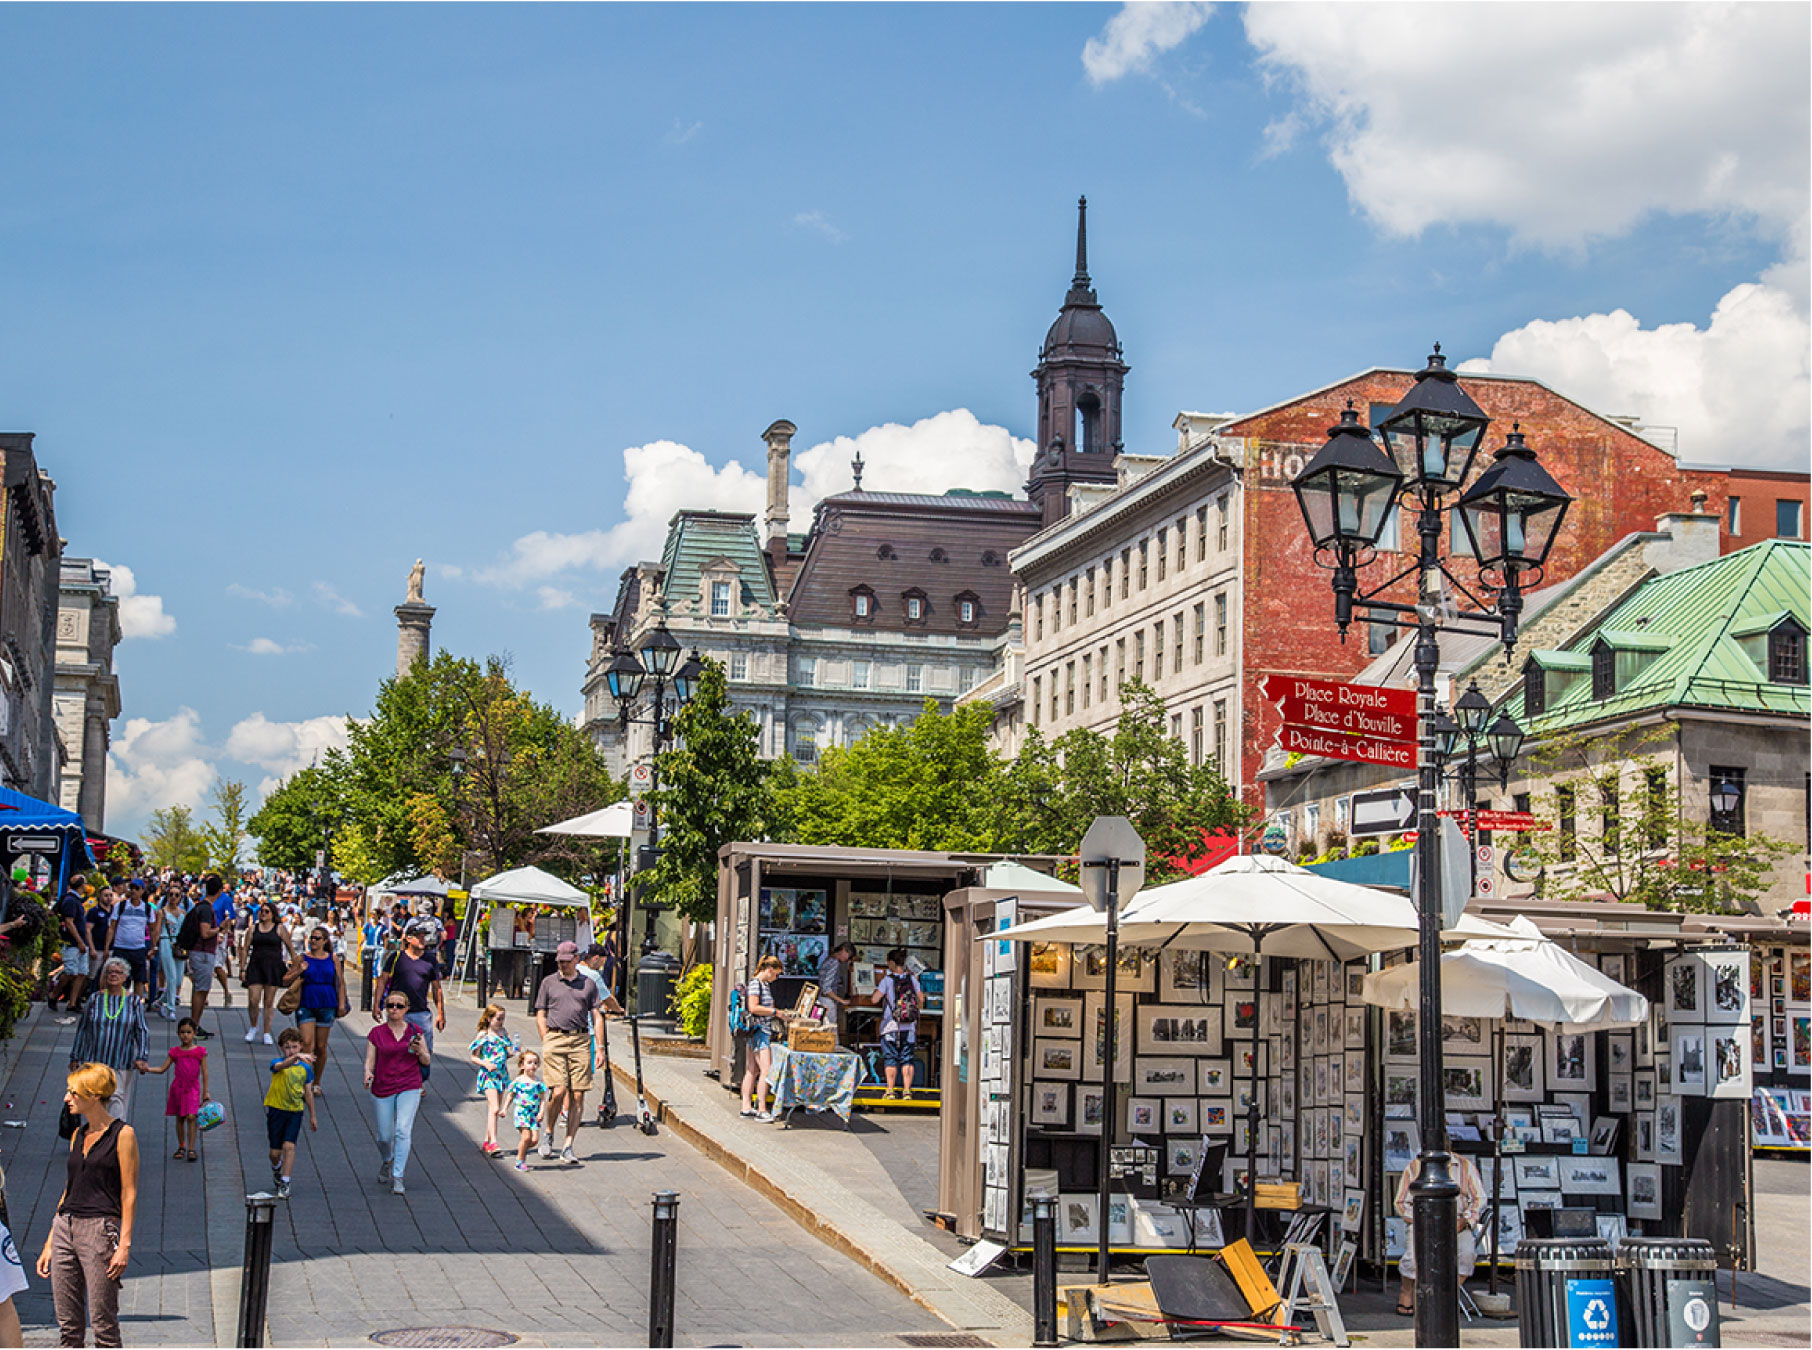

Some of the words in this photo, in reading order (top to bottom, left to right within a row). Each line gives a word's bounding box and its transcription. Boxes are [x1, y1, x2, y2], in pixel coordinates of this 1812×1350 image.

[1294, 681, 1334, 702] Place
[1338, 686, 1388, 709] Royale
[1304, 703, 1340, 725] Place
[1343, 709, 1403, 735] d'Youville
[1290, 730, 1410, 763] Pointe-à-Callière
